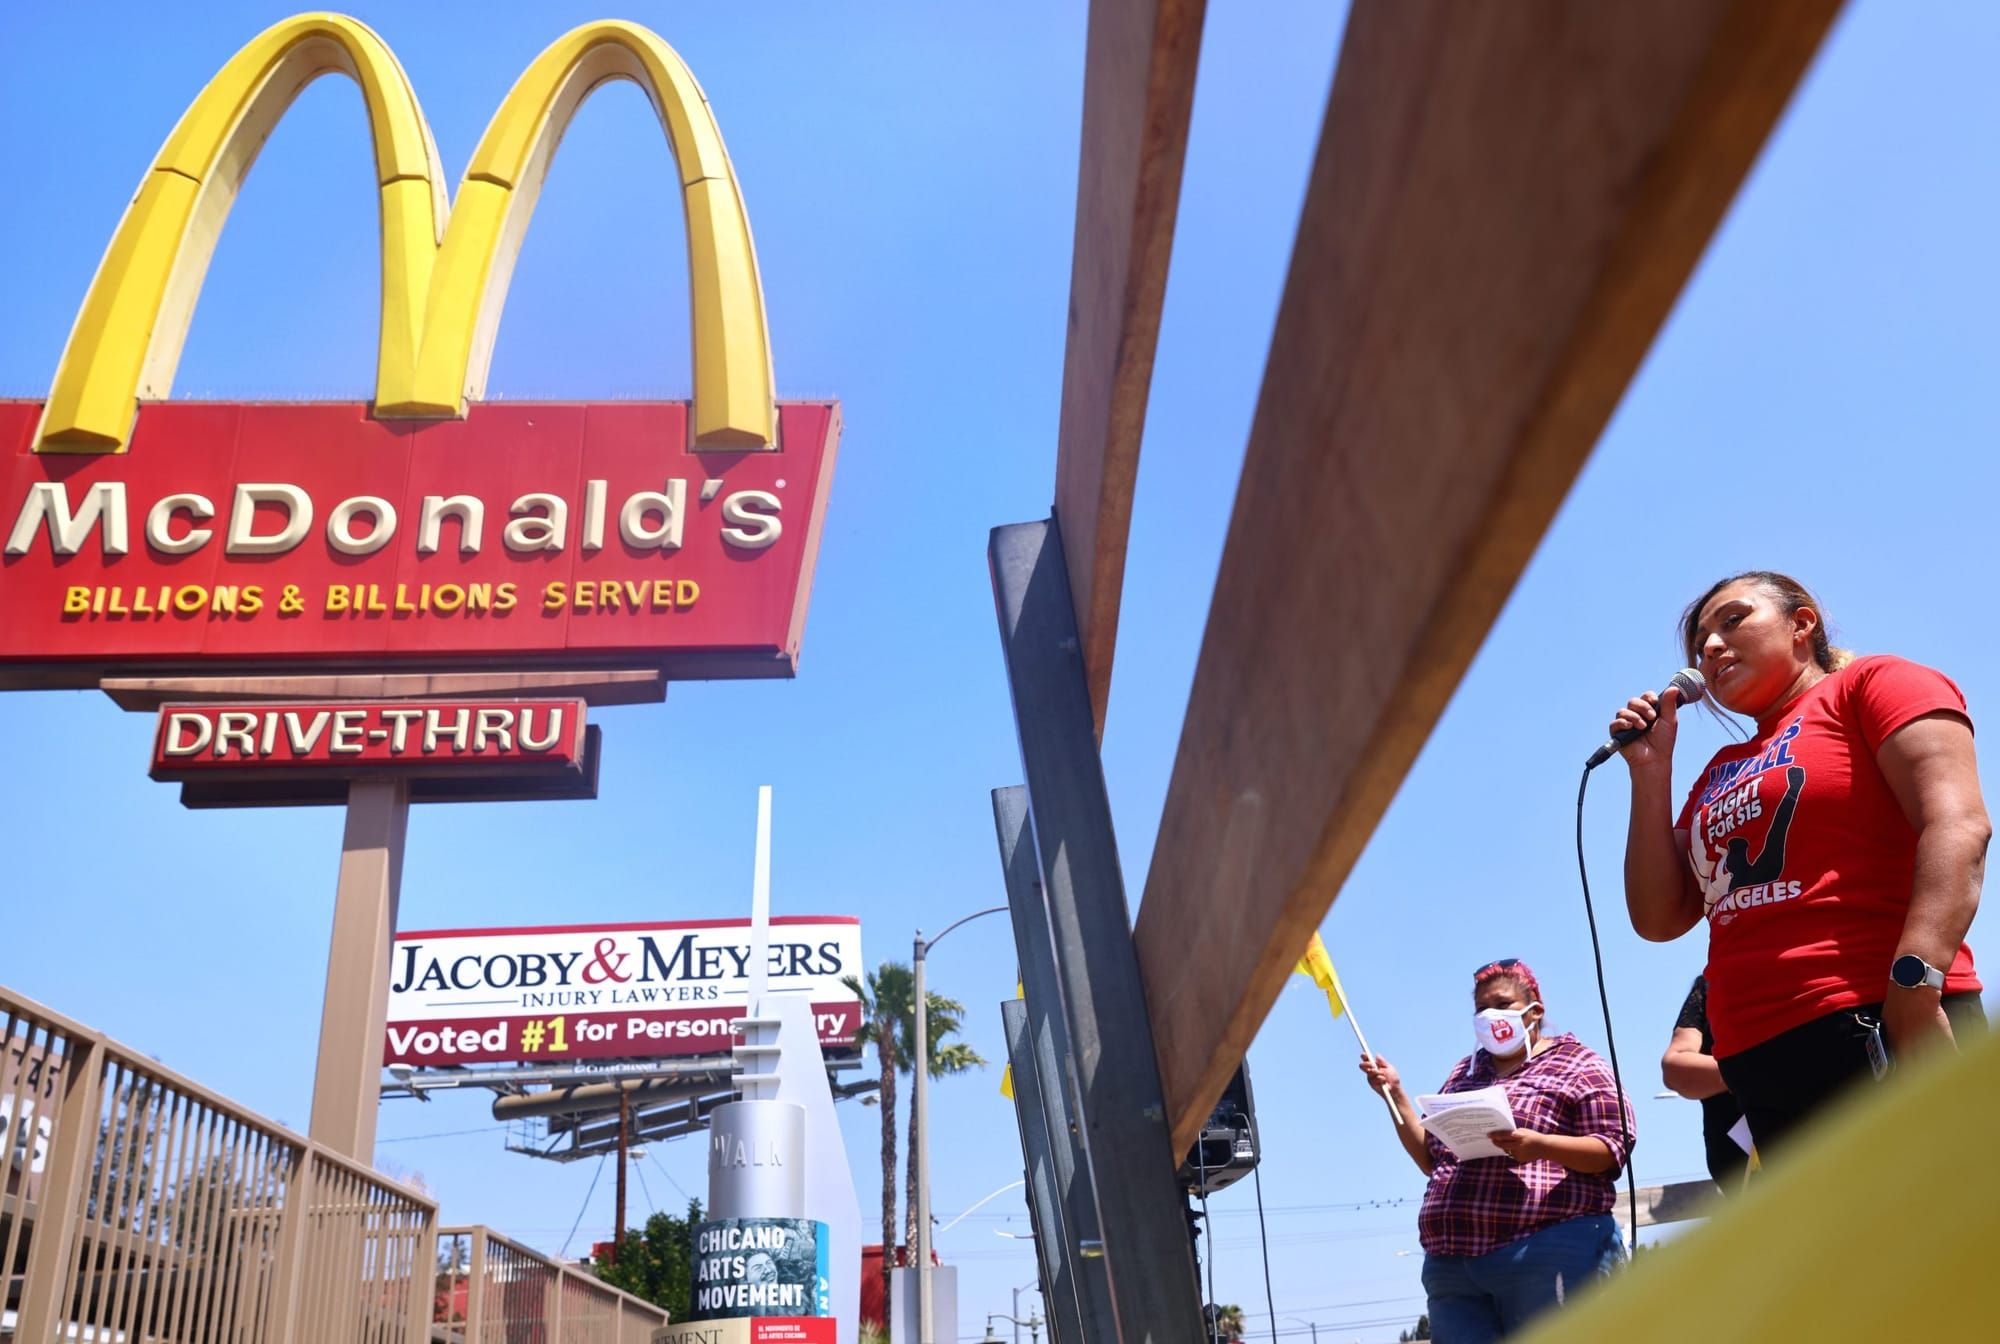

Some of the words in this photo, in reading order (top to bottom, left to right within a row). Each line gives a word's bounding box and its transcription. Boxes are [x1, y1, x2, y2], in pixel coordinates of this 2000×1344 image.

[5, 479, 783, 556] McDonald's
[64, 585, 263, 616] BILLIONS
[280, 585, 305, 613] &
[325, 583, 518, 613] BILLIONS
[543, 579, 700, 611] SERVED
[164, 708, 564, 757] DRIVE-THRU
[1707, 776, 1764, 826] FIGHT
[1708, 814, 1736, 844] FOR
[1737, 799, 1762, 826] $15
[392, 946, 583, 993] JACOBY
[581, 937, 632, 984] &
[637, 935, 842, 982] MEYERS
[521, 990, 602, 1008] INJURY
[612, 986, 718, 1004] LAWYERS
[387, 1022, 508, 1056] Voted
[520, 1016, 569, 1053] #1
[575, 1019, 618, 1042] for
[700, 1226, 785, 1254] CHICANO
[699, 1257, 745, 1282] ARTS
[699, 1283, 804, 1311] MOVEMENT
